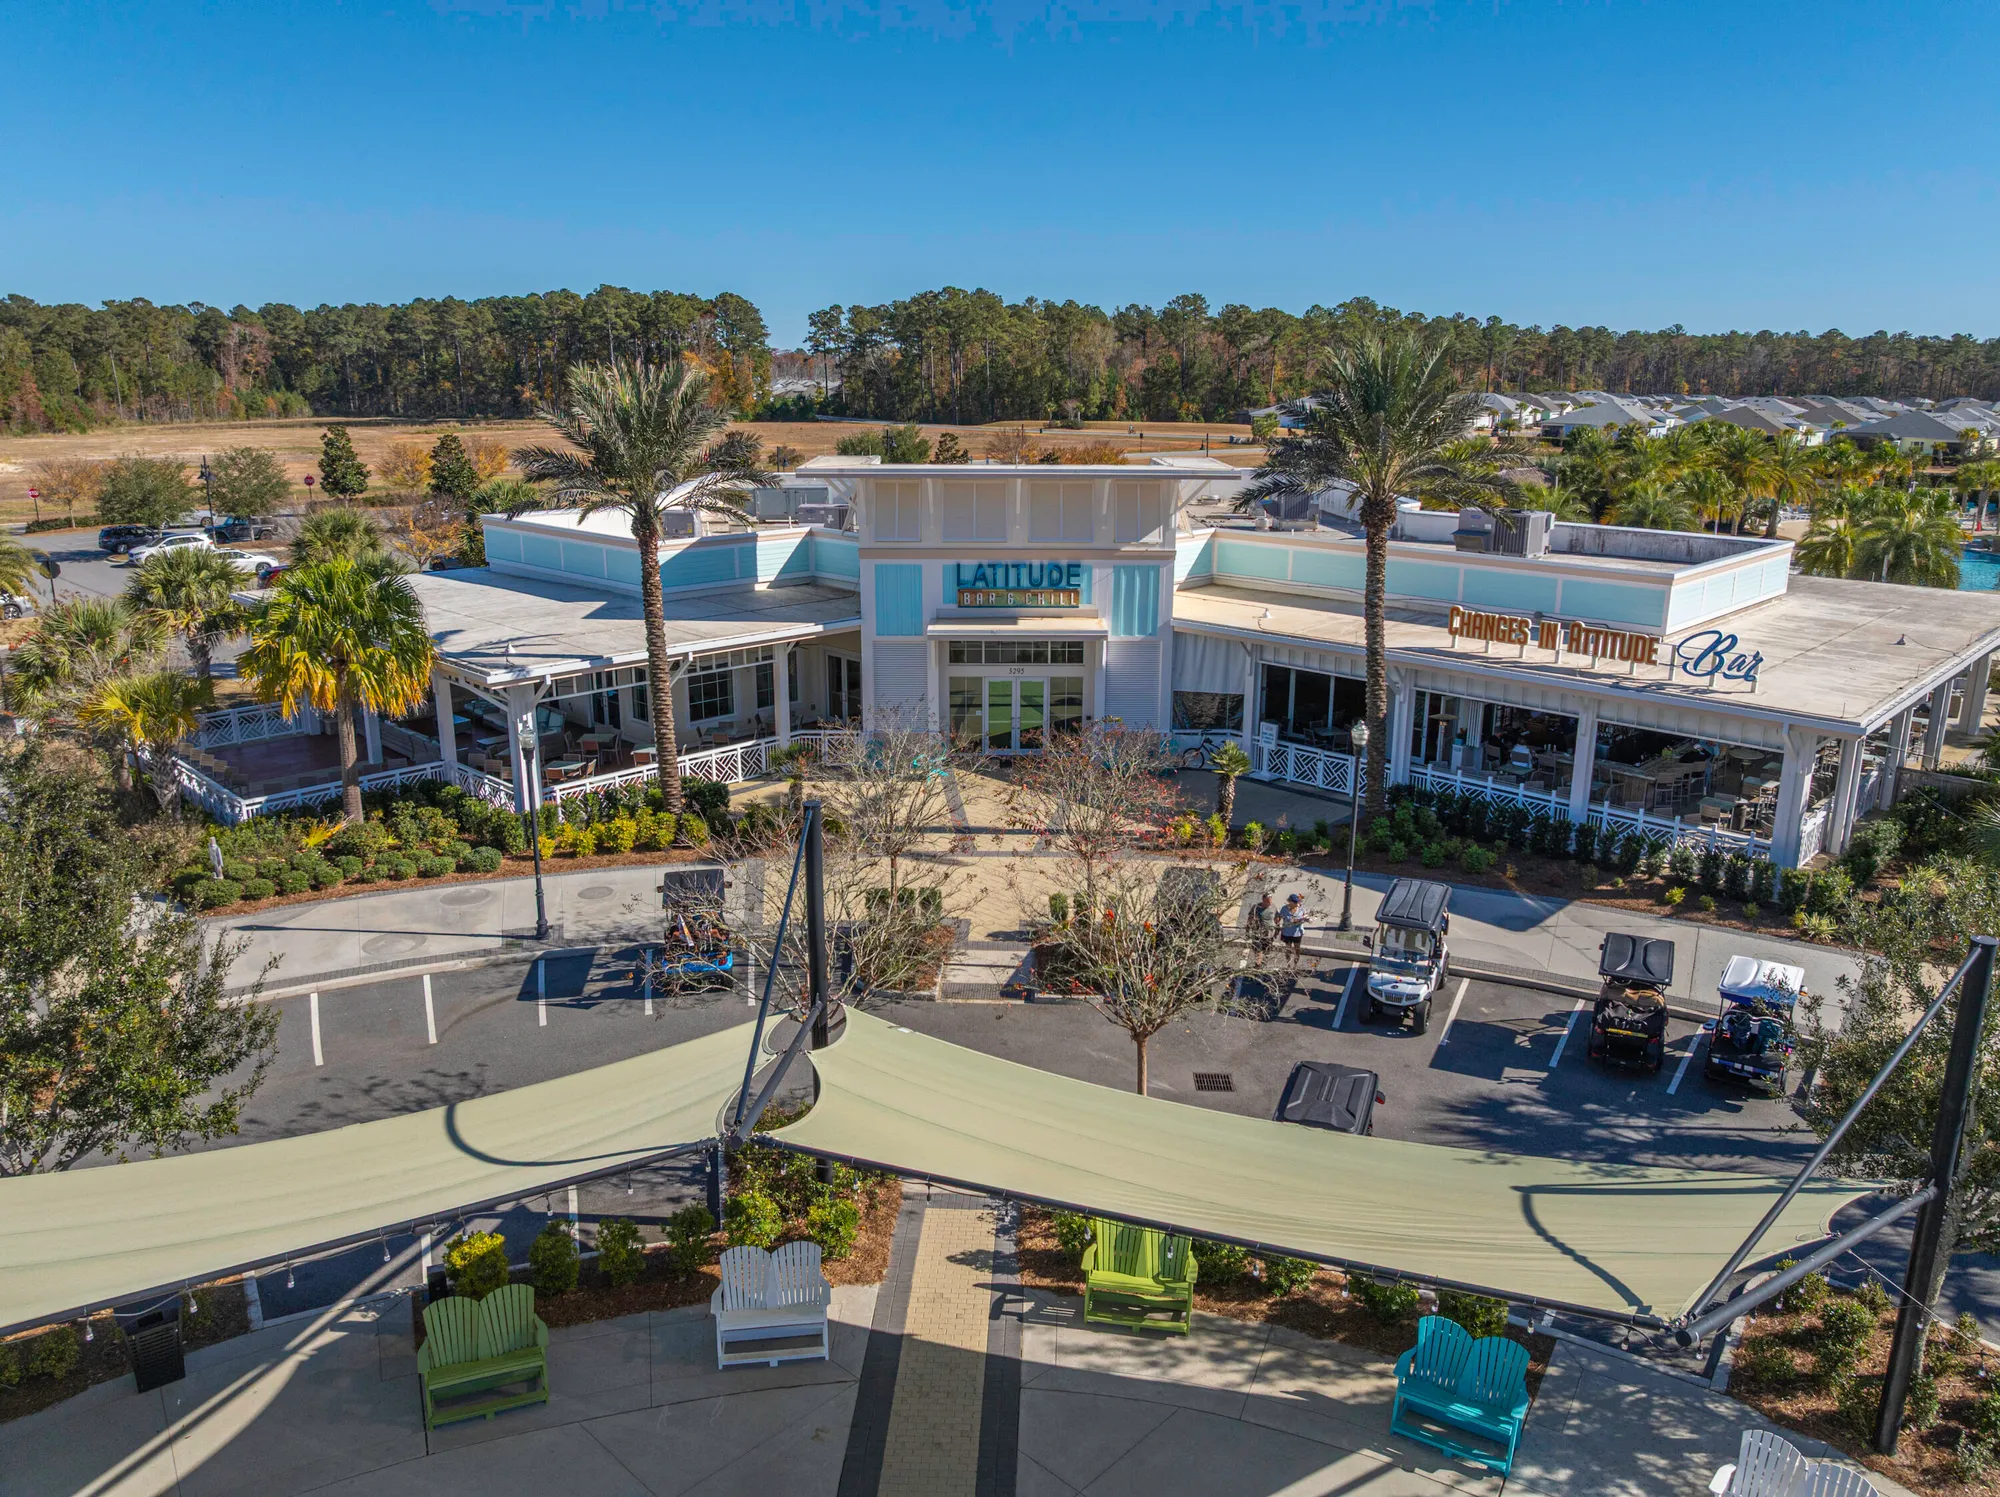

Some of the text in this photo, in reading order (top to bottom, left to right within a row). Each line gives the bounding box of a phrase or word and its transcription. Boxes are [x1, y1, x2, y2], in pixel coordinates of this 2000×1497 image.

[957, 563, 1081, 588] LATITUDE
[963, 592, 1077, 605] BAR & CHILL
[1448, 605, 1764, 682] CHANGES IN ATTITUDE Bar
[1008, 667, 1025, 675] 3295
